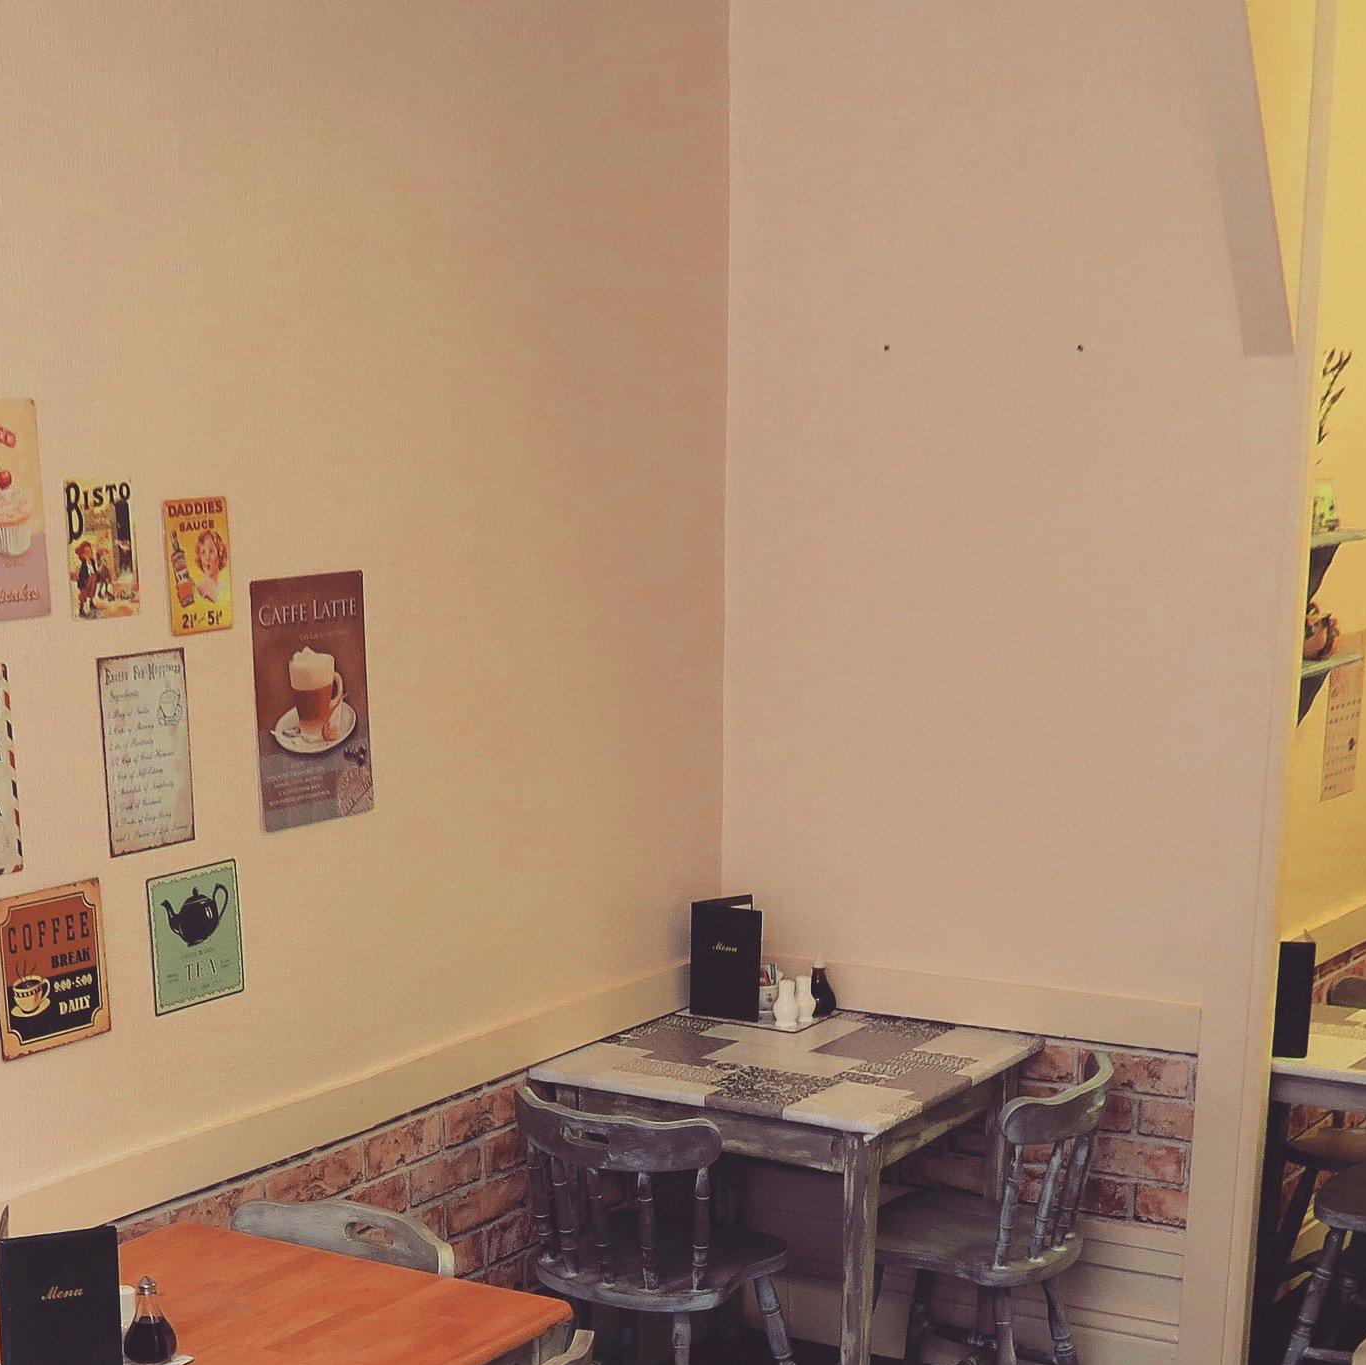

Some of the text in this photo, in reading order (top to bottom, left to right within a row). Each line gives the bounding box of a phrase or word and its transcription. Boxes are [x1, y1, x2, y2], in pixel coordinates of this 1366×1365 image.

[64, 481, 132, 545] BISTO
[167, 500, 223, 519] DADDIES
[178, 519, 216, 533] SAUCE
[312, 597, 357, 620] LATTE
[7, 911, 91, 954] COFFEE
[49, 947, 91, 969] BREAK
[712, 942, 738, 953] Menu
[58, 994, 91, 1015] DAILY
[41, 1285, 86, 1301] Menu
